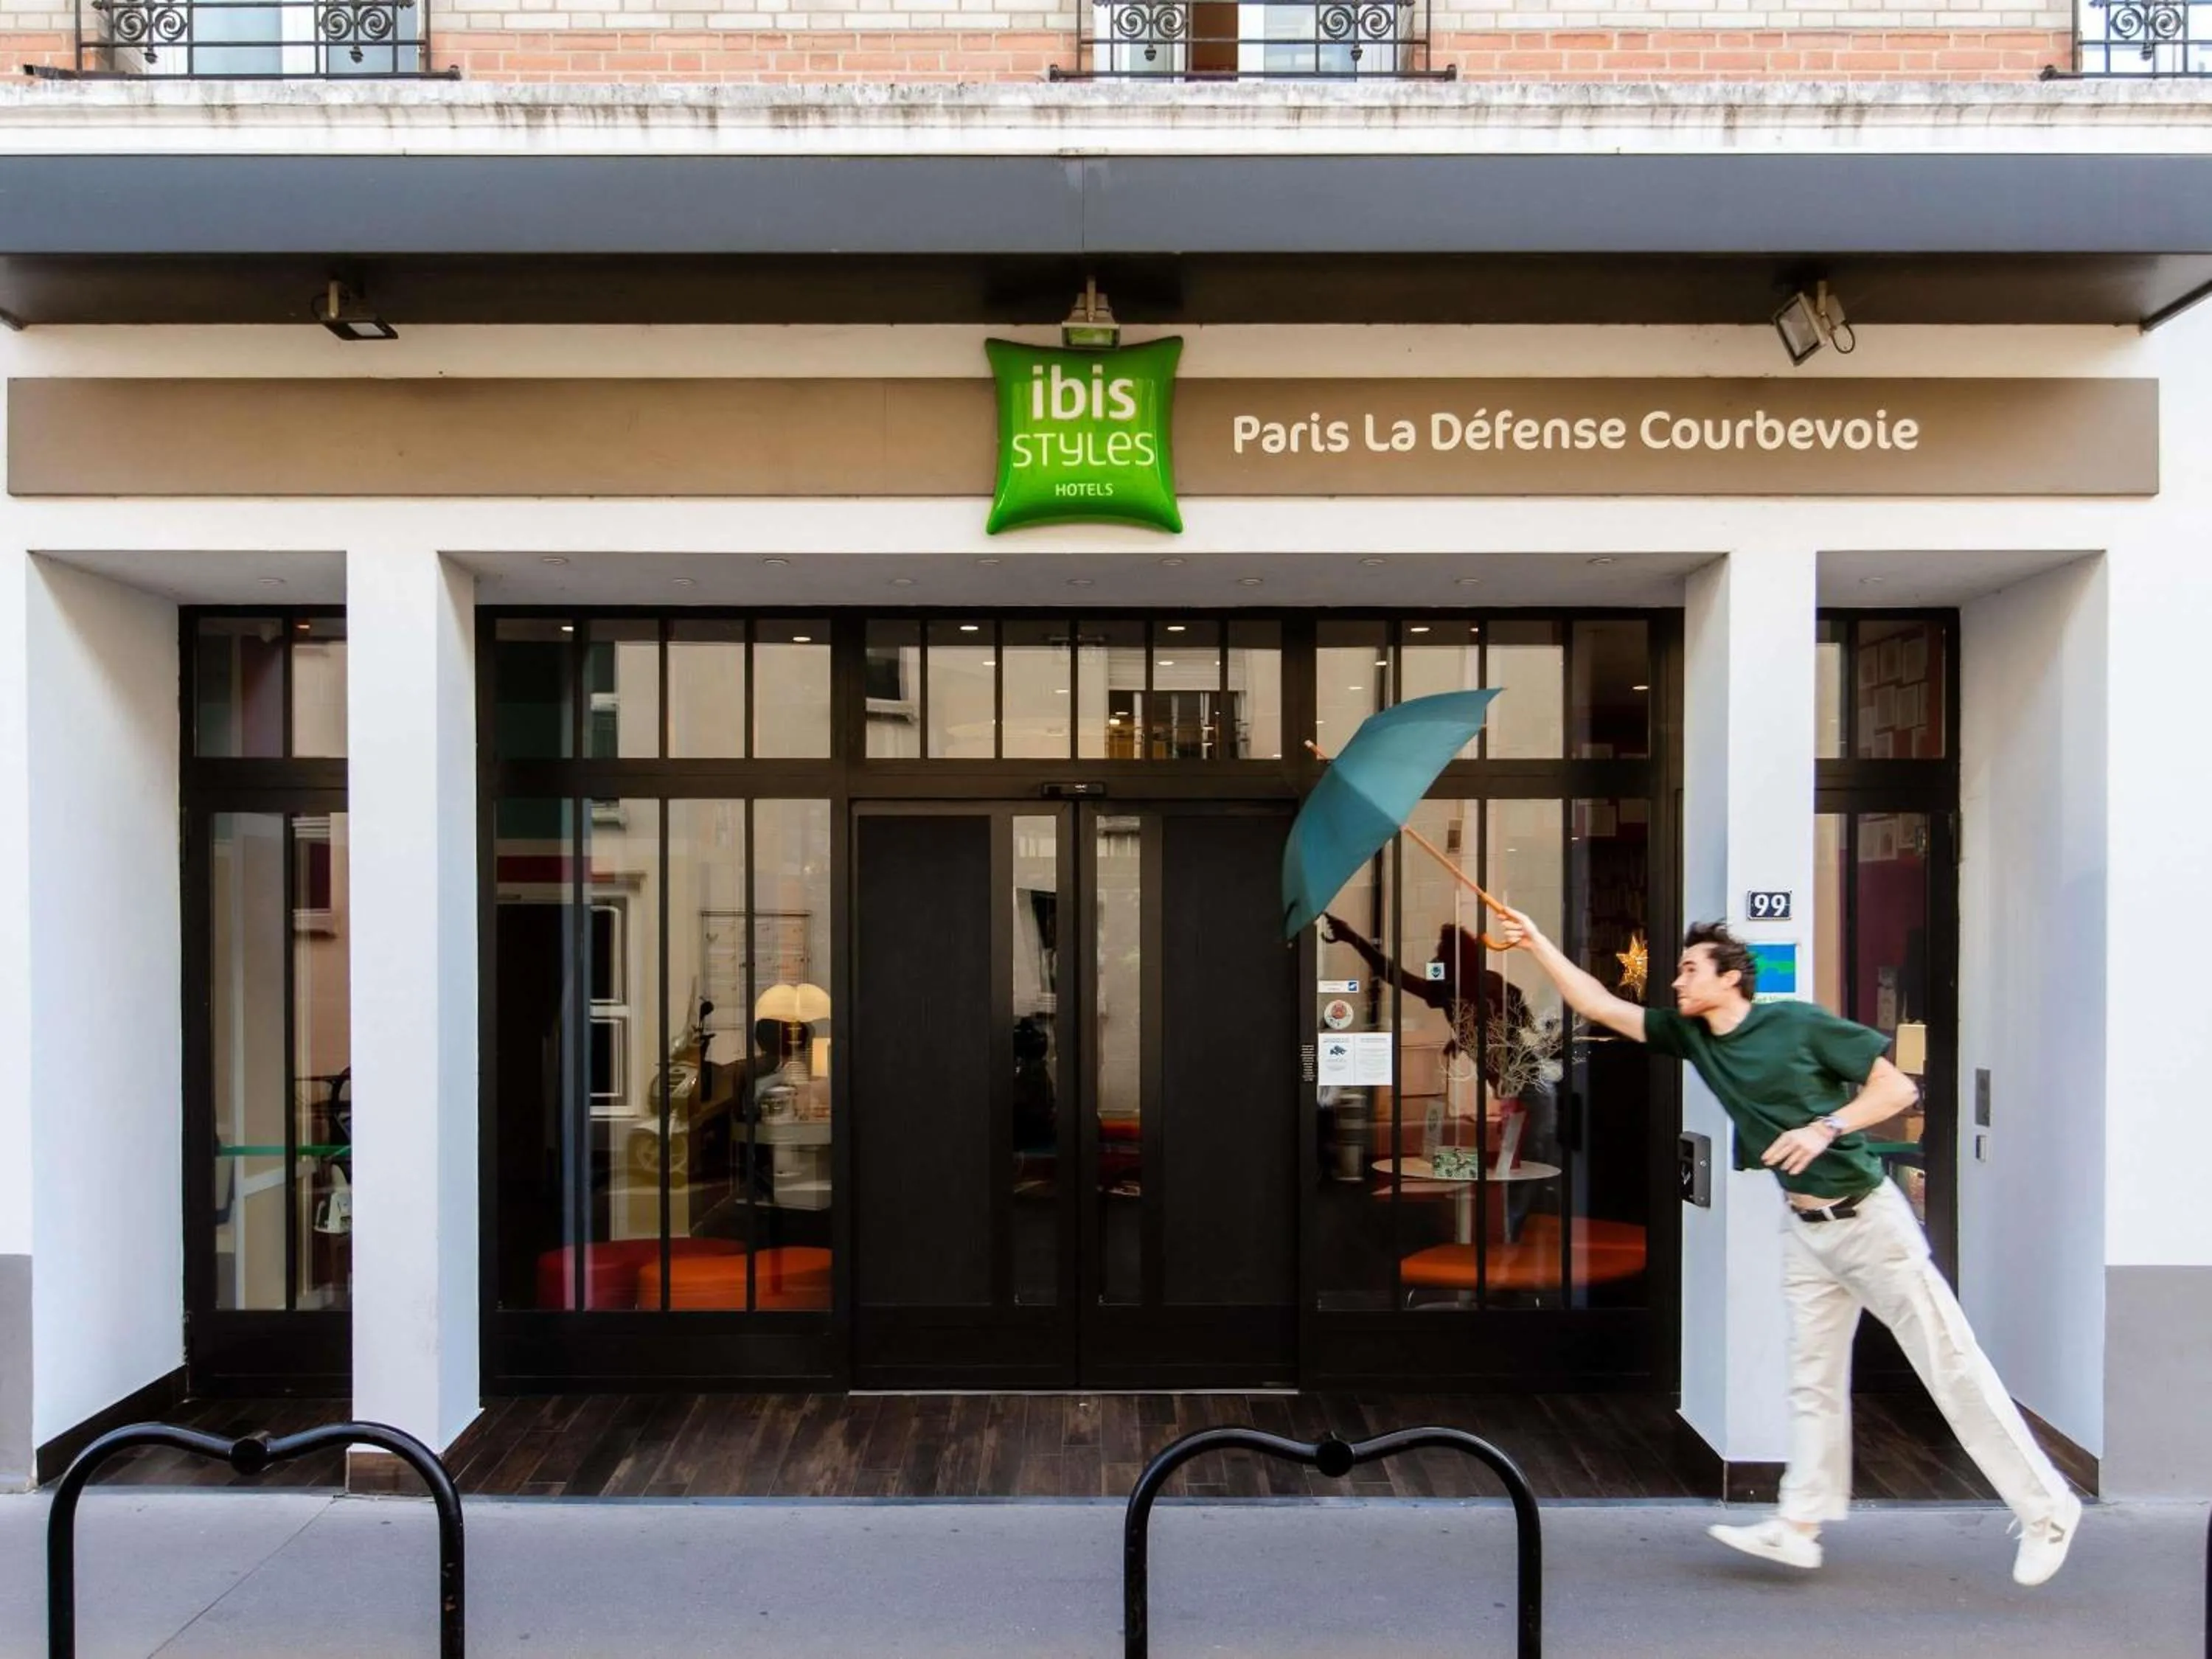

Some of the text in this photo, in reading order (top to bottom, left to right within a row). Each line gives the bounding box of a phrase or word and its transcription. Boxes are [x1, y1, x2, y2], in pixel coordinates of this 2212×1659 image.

[1033, 365, 1136, 420] ibis
[1234, 408, 1919, 453] Paris La Défense Courbevoie
[1055, 483, 1113, 497] HOTELS
[1754, 894, 1787, 917] 99
